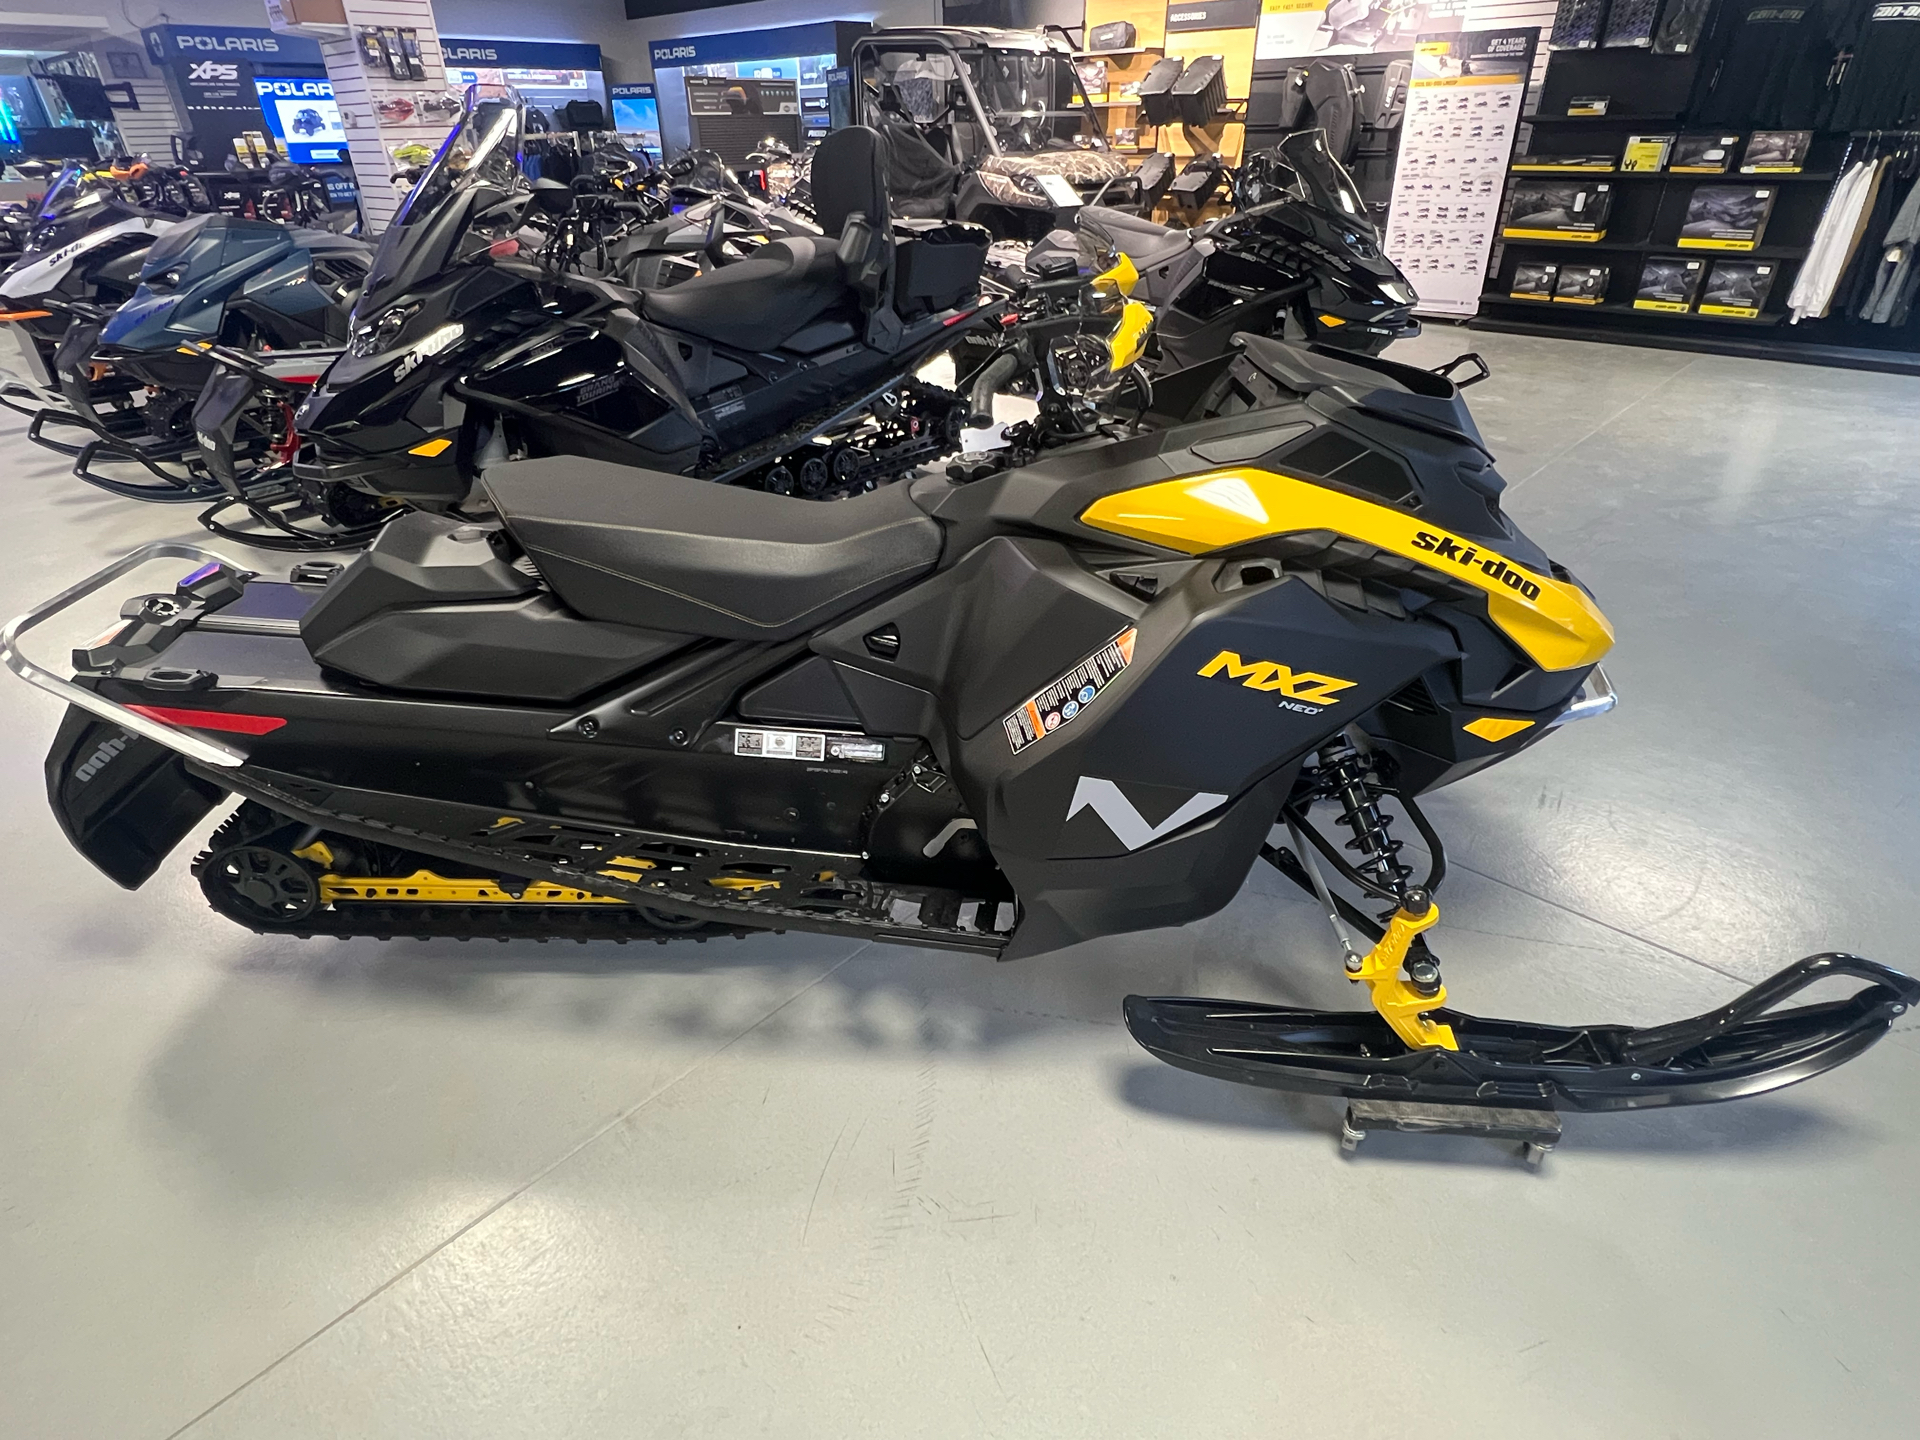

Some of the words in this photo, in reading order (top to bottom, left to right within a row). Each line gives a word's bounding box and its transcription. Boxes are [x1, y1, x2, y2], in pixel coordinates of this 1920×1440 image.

[176, 34, 280, 53] POLARIS
[654, 45, 696, 61] POLARIS
[188, 60, 239, 80] XPS
[611, 86, 653, 95] POLARIS
[1411, 531, 1541, 602] ski-doo
[1196, 650, 1359, 706] MXZ
